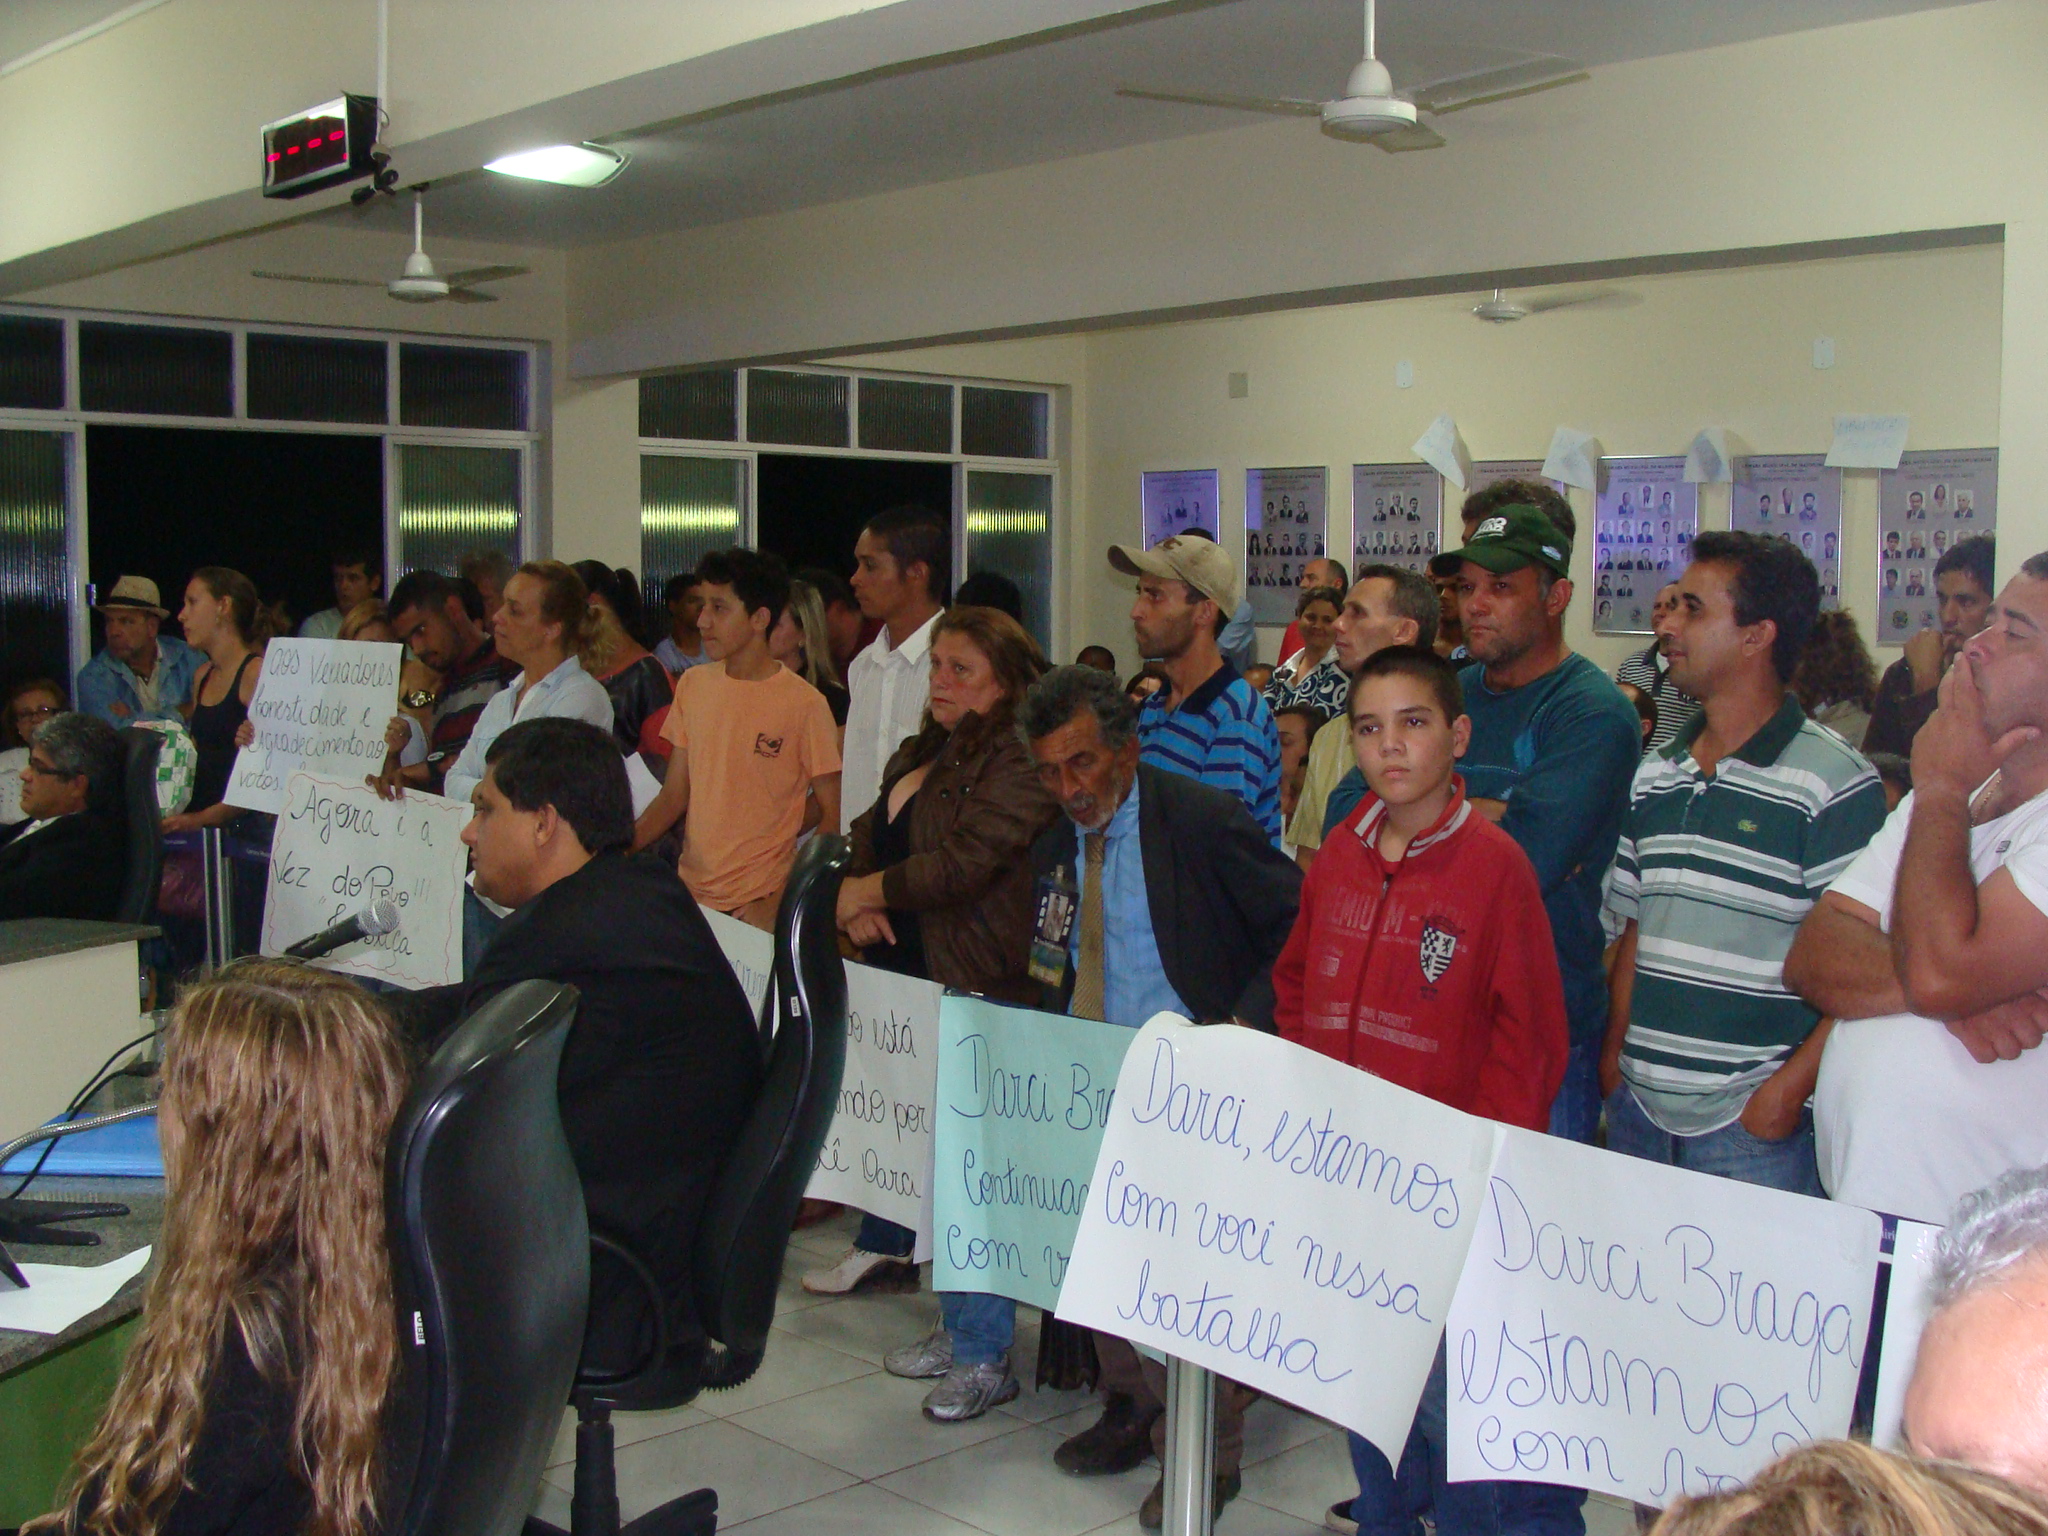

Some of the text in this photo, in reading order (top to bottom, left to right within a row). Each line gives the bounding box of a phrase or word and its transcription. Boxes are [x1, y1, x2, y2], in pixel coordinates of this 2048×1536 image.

[290, 785, 380, 844] Agora
[420, 821, 433, 847] a
[332, 865, 362, 897] do
[872, 1009, 917, 1058] está
[949, 1033, 1054, 1122] Darci
[893, 1100, 929, 1143] por
[1132, 1037, 1461, 1229] Darci, estamos
[1195, 1201, 1275, 1267] você
[1296, 1235, 1432, 1323] nessa
[1489, 1176, 1859, 1404] Darci Braga
[1117, 1258, 1353, 1383] batalha
[1458, 1308, 1816, 1457] estamos
